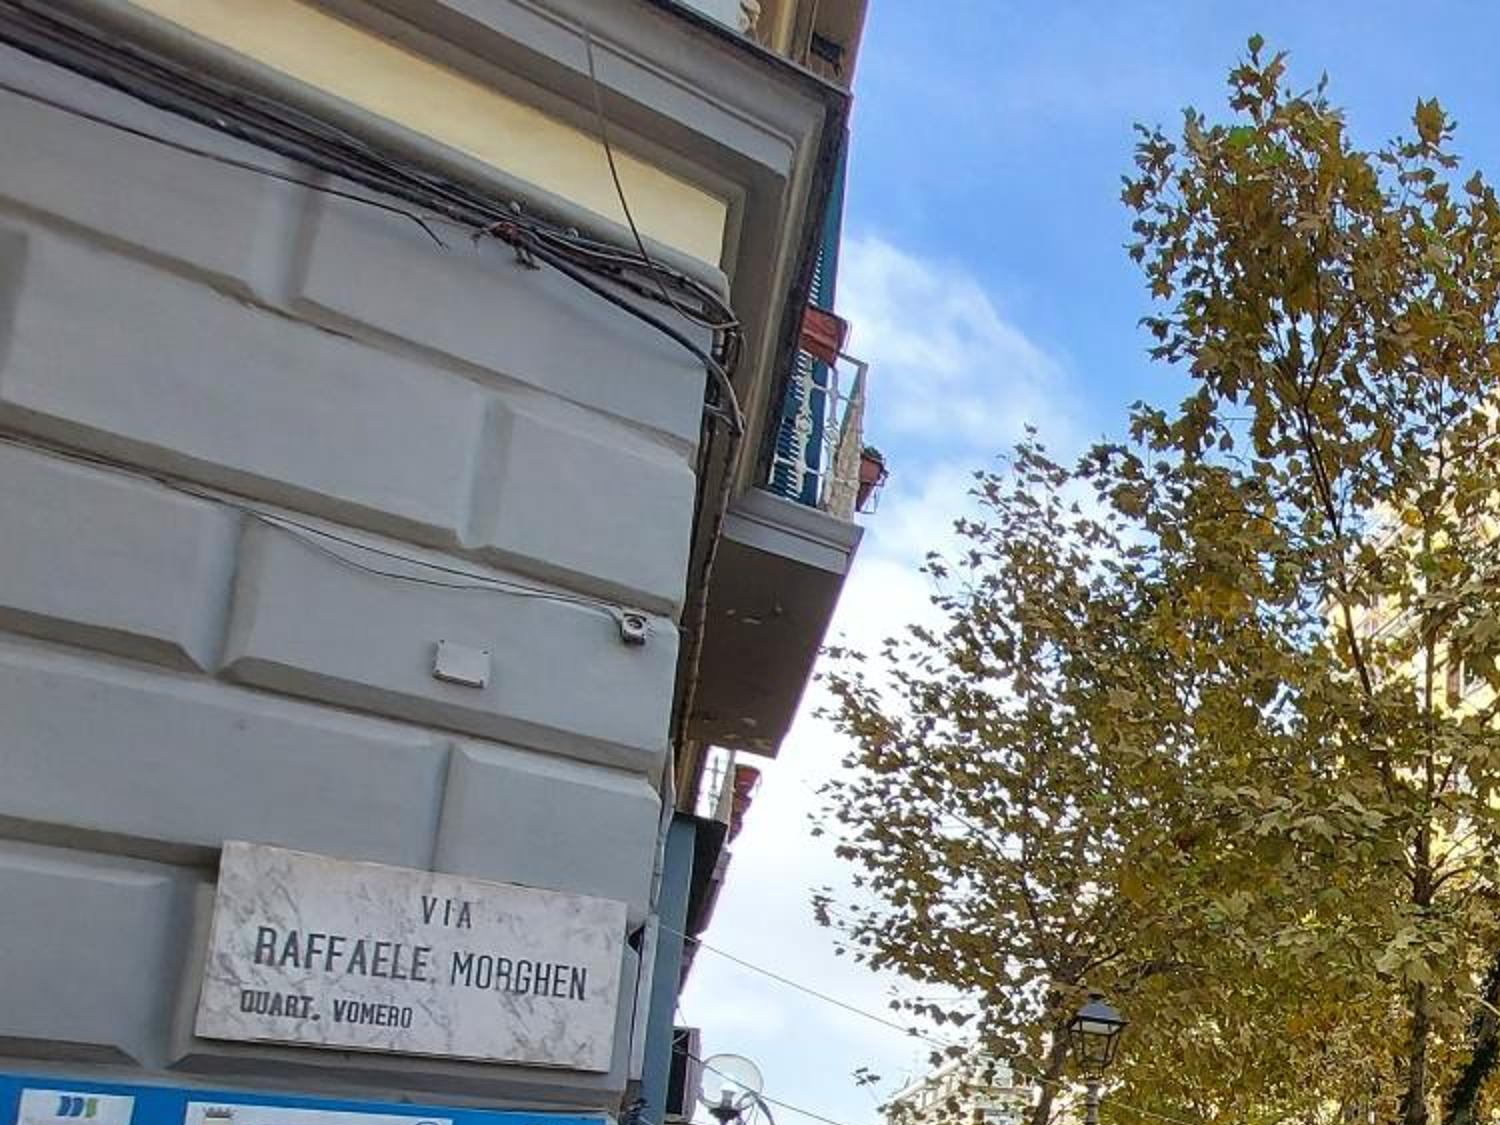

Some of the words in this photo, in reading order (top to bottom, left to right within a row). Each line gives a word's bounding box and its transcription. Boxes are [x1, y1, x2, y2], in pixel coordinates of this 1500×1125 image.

[420, 895, 473, 929] VIA
[254, 926, 431, 982] RAFFAELE
[450, 950, 588, 1001] MORGHEN
[240, 989, 321, 1021] QUART.
[333, 999, 413, 1029] VOMERO
